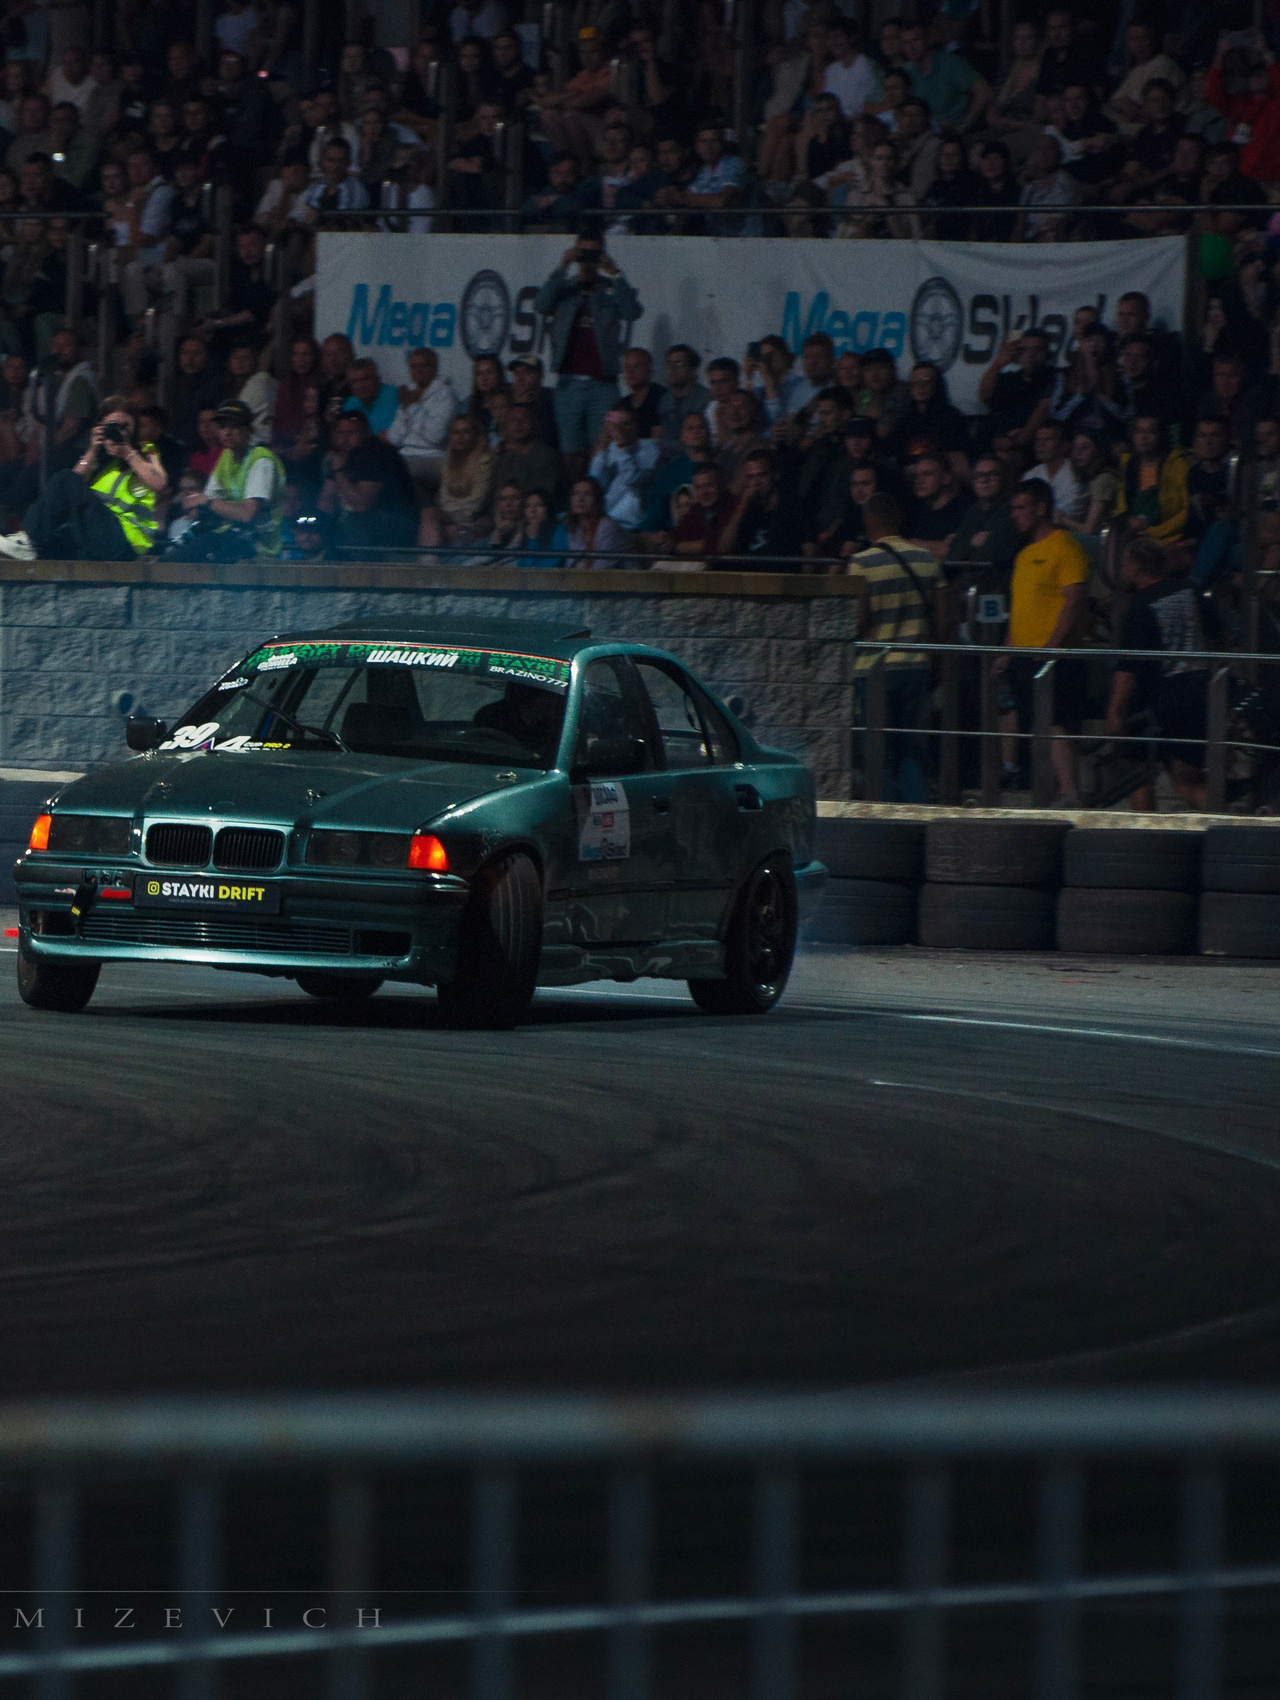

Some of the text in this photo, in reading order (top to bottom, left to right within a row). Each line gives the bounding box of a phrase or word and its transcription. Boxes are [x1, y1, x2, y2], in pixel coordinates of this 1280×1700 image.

[343, 284, 456, 350] Mega
[781, 291, 907, 358] Mega
[366, 650, 459, 668] ШАЦКИЙ
[158, 721, 220, 750] 39
[161, 881, 265, 901] STAYKI DRIFT
